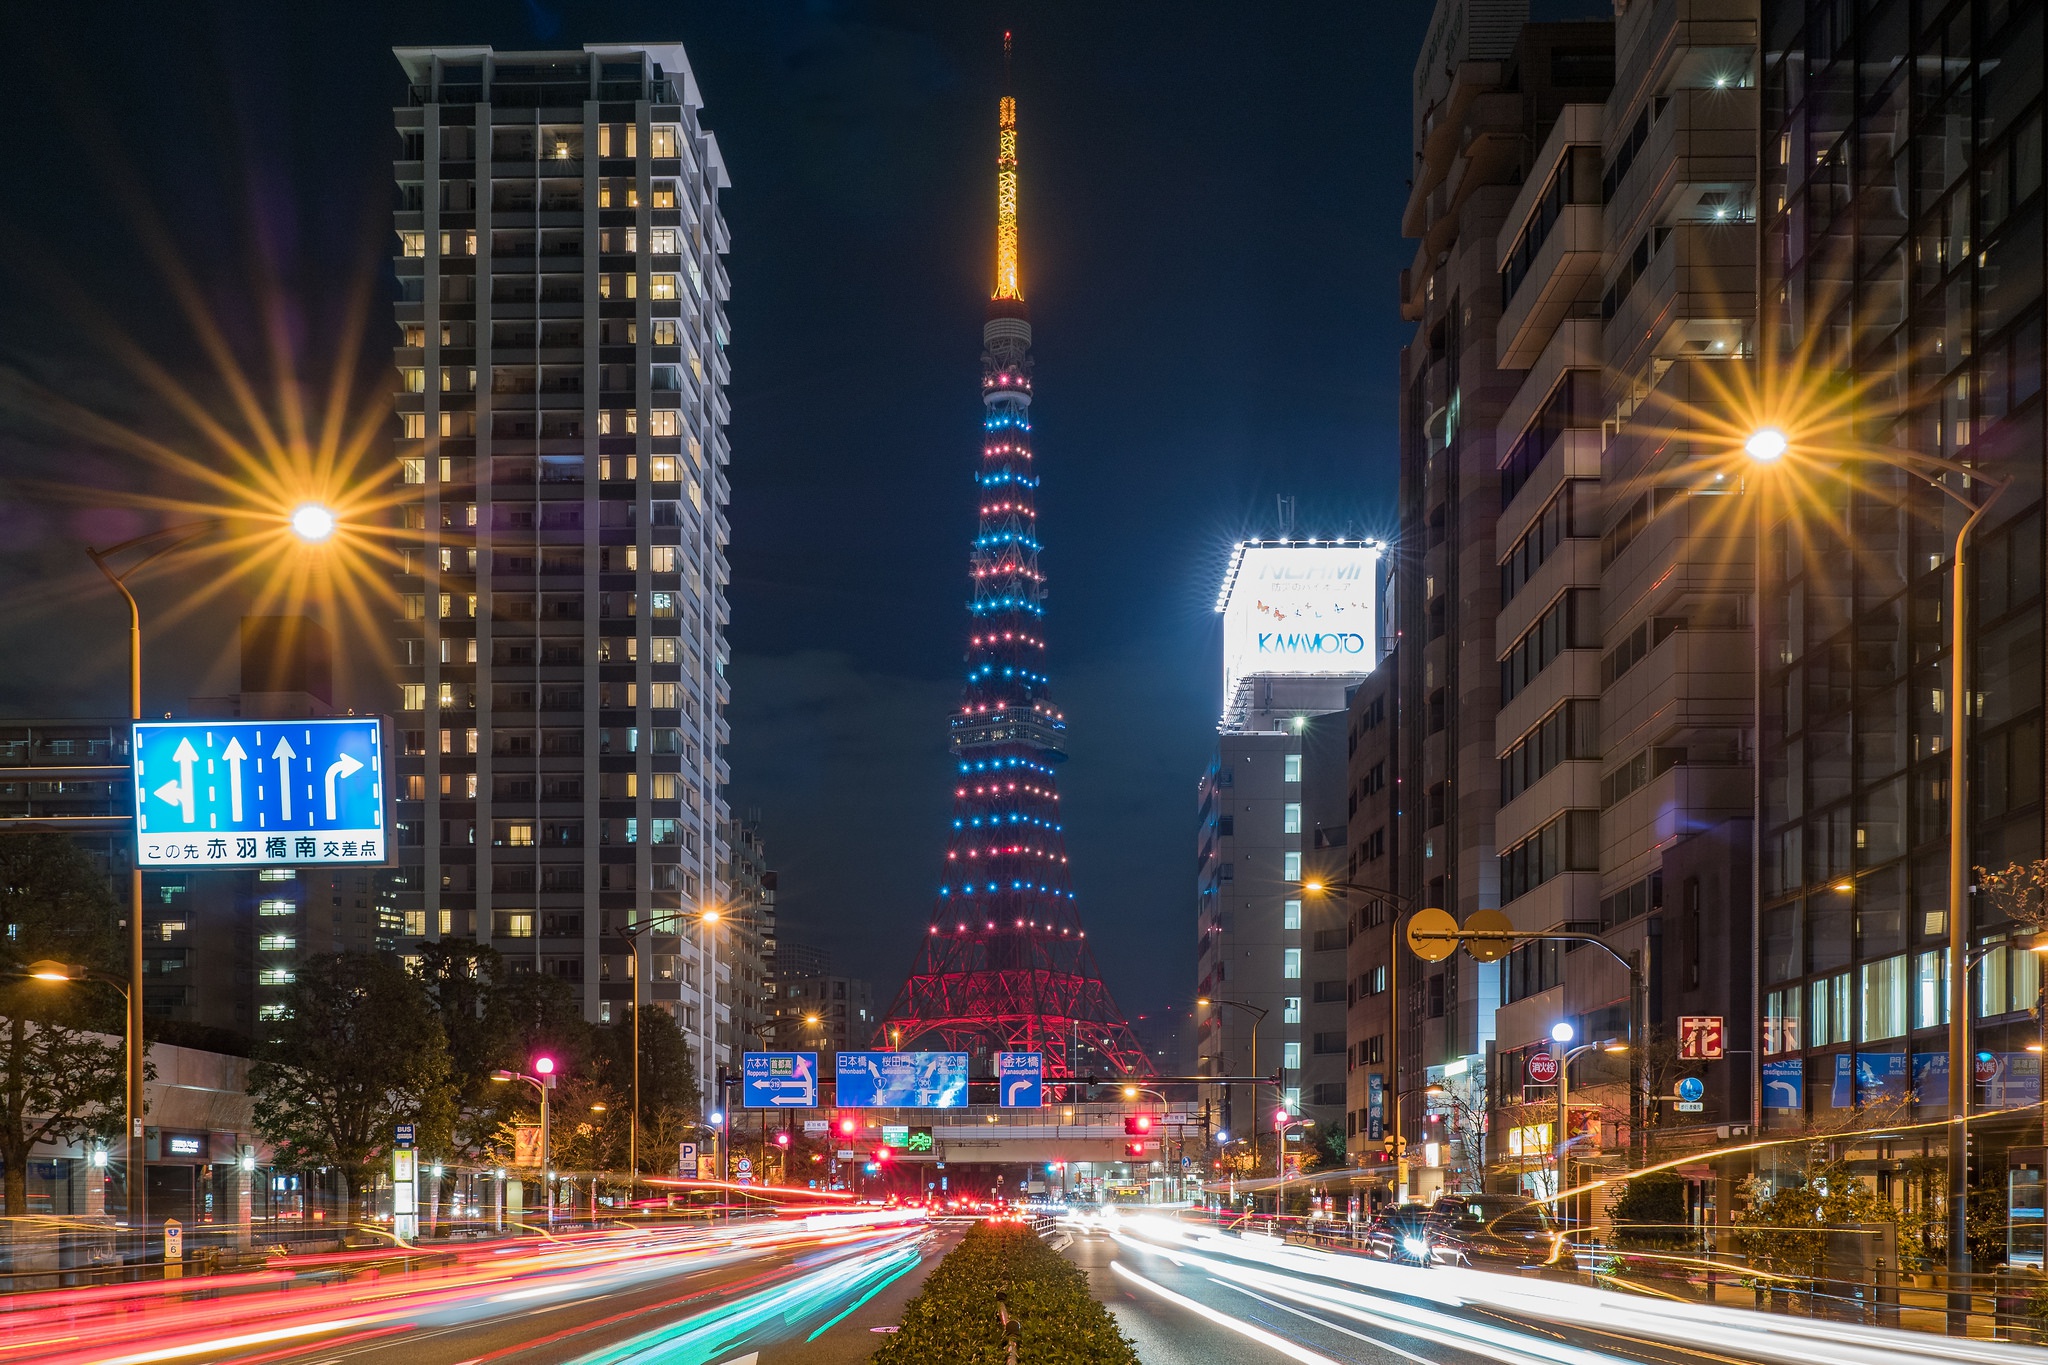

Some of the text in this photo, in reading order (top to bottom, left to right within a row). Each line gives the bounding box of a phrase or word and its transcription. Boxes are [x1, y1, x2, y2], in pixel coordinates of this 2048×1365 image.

[1684, 1018, 1721, 1056] 花
[747, 1057, 769, 1069] 六本木
[771, 1060, 792, 1068] 首都高
[839, 1056, 867, 1067] 日本橋
[882, 1056, 911, 1067] 桜田門
[1003, 1056, 1039, 1067] 金杉橋
[1532, 1061, 1555, 1073] 消火栓
[1003, 1068, 1039, 1076] Kanasugibashi
[683, 1146, 693, 1158] P
[170, 1245, 177, 1253] 6
